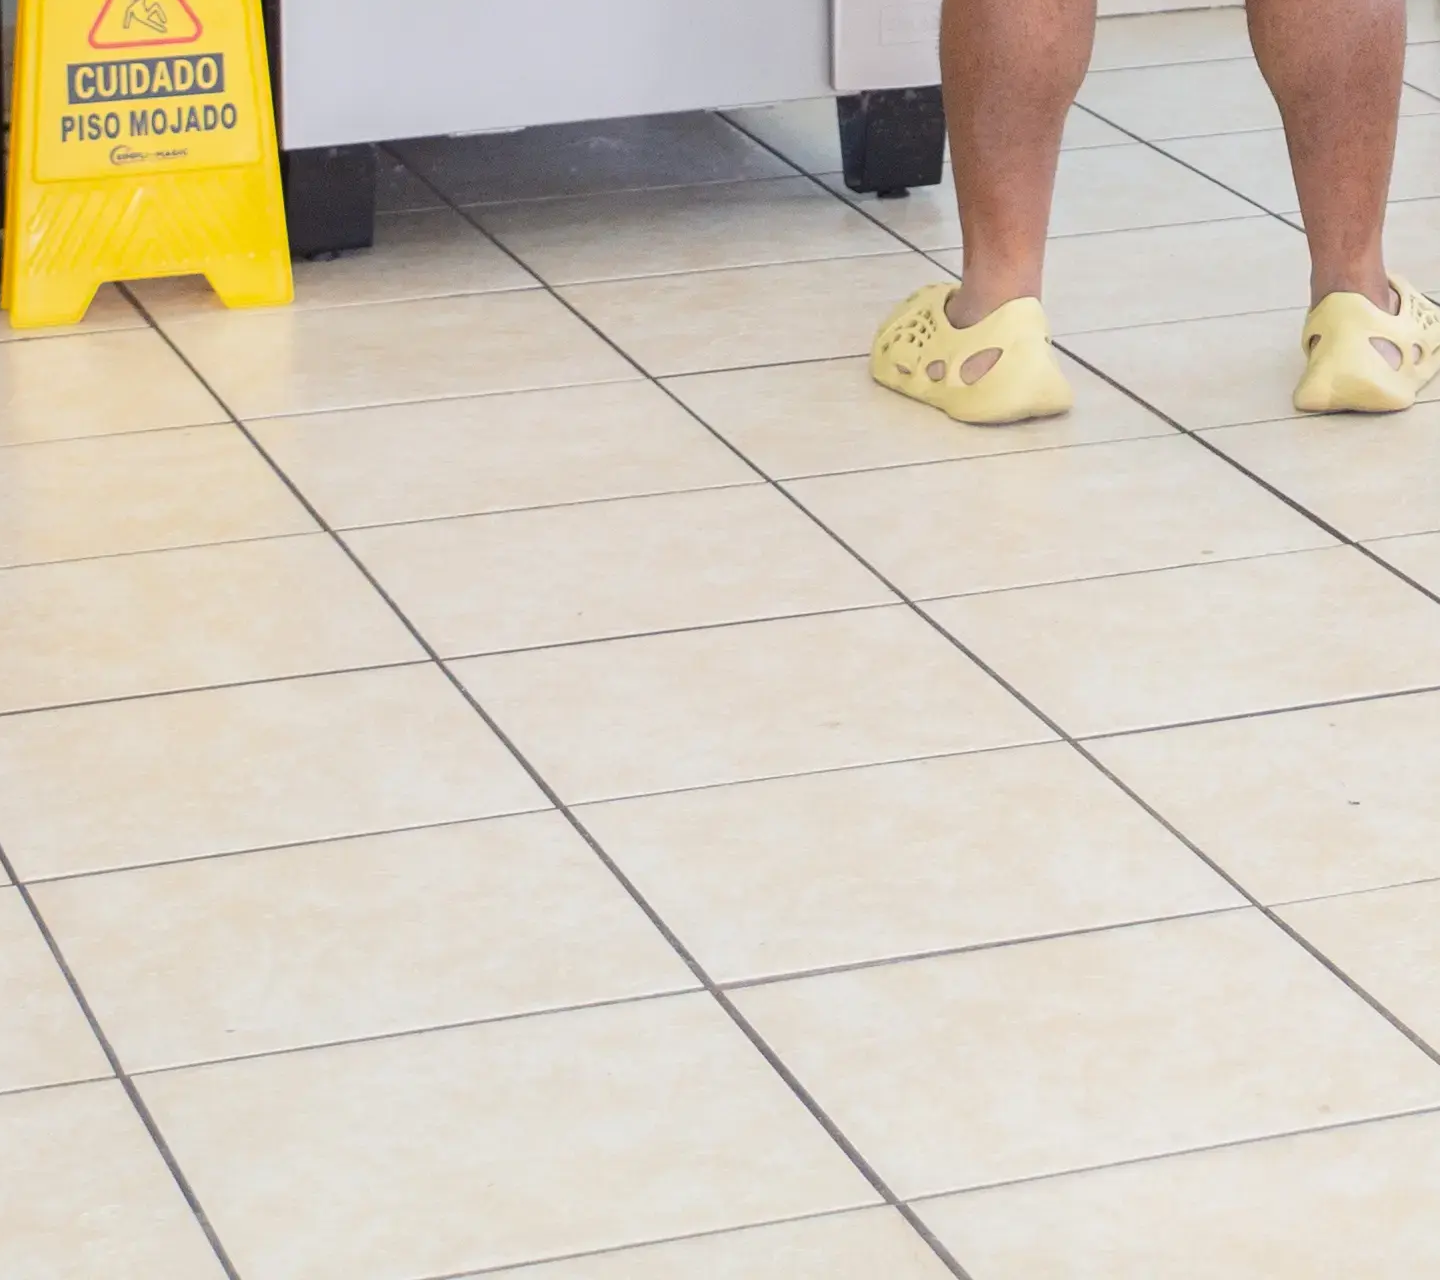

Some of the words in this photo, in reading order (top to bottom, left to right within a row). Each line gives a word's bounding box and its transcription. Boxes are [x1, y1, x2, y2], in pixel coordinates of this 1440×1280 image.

[73, 56, 220, 101] CUIDADO
[61, 111, 121, 142] PISO
[130, 102, 238, 137] MOJADO
